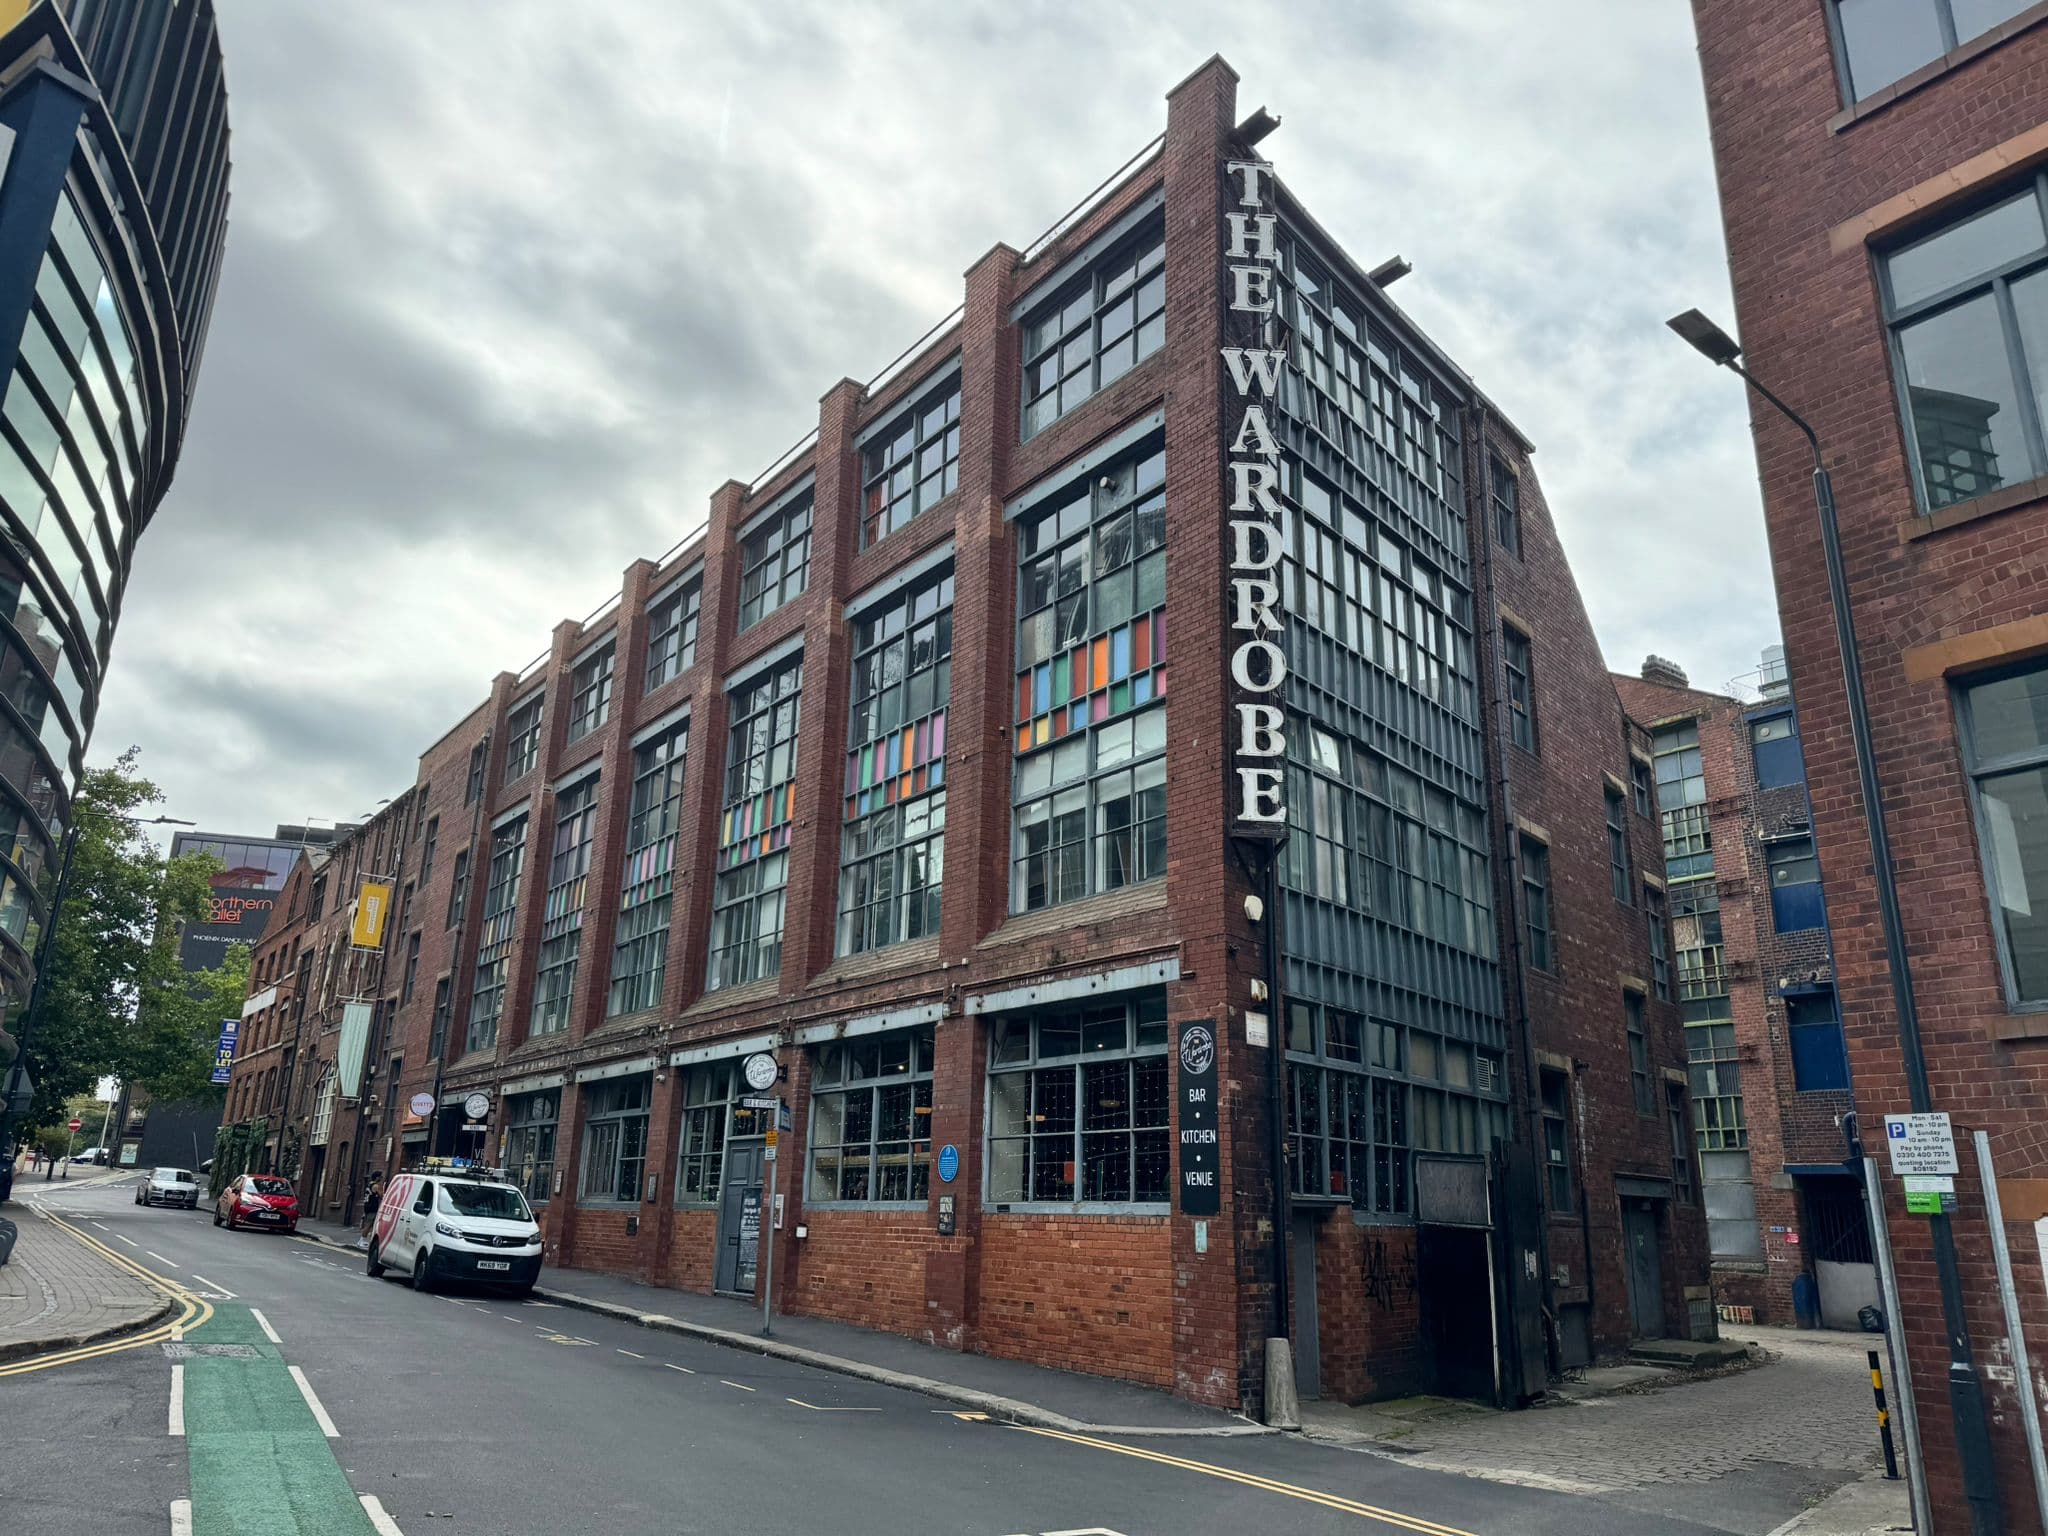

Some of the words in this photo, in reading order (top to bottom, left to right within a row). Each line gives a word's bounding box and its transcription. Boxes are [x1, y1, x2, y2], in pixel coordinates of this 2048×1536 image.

[1225, 160, 1278, 313] THE
[1220, 347, 1287, 823] WARDROBE
[220, 1049, 232, 1058] TO
[215, 1058, 232, 1067] LET
[1189, 1088, 1206, 1103] BAR
[1181, 1128, 1216, 1144] KITCHEN
[1185, 1171, 1213, 1187] VENUE
